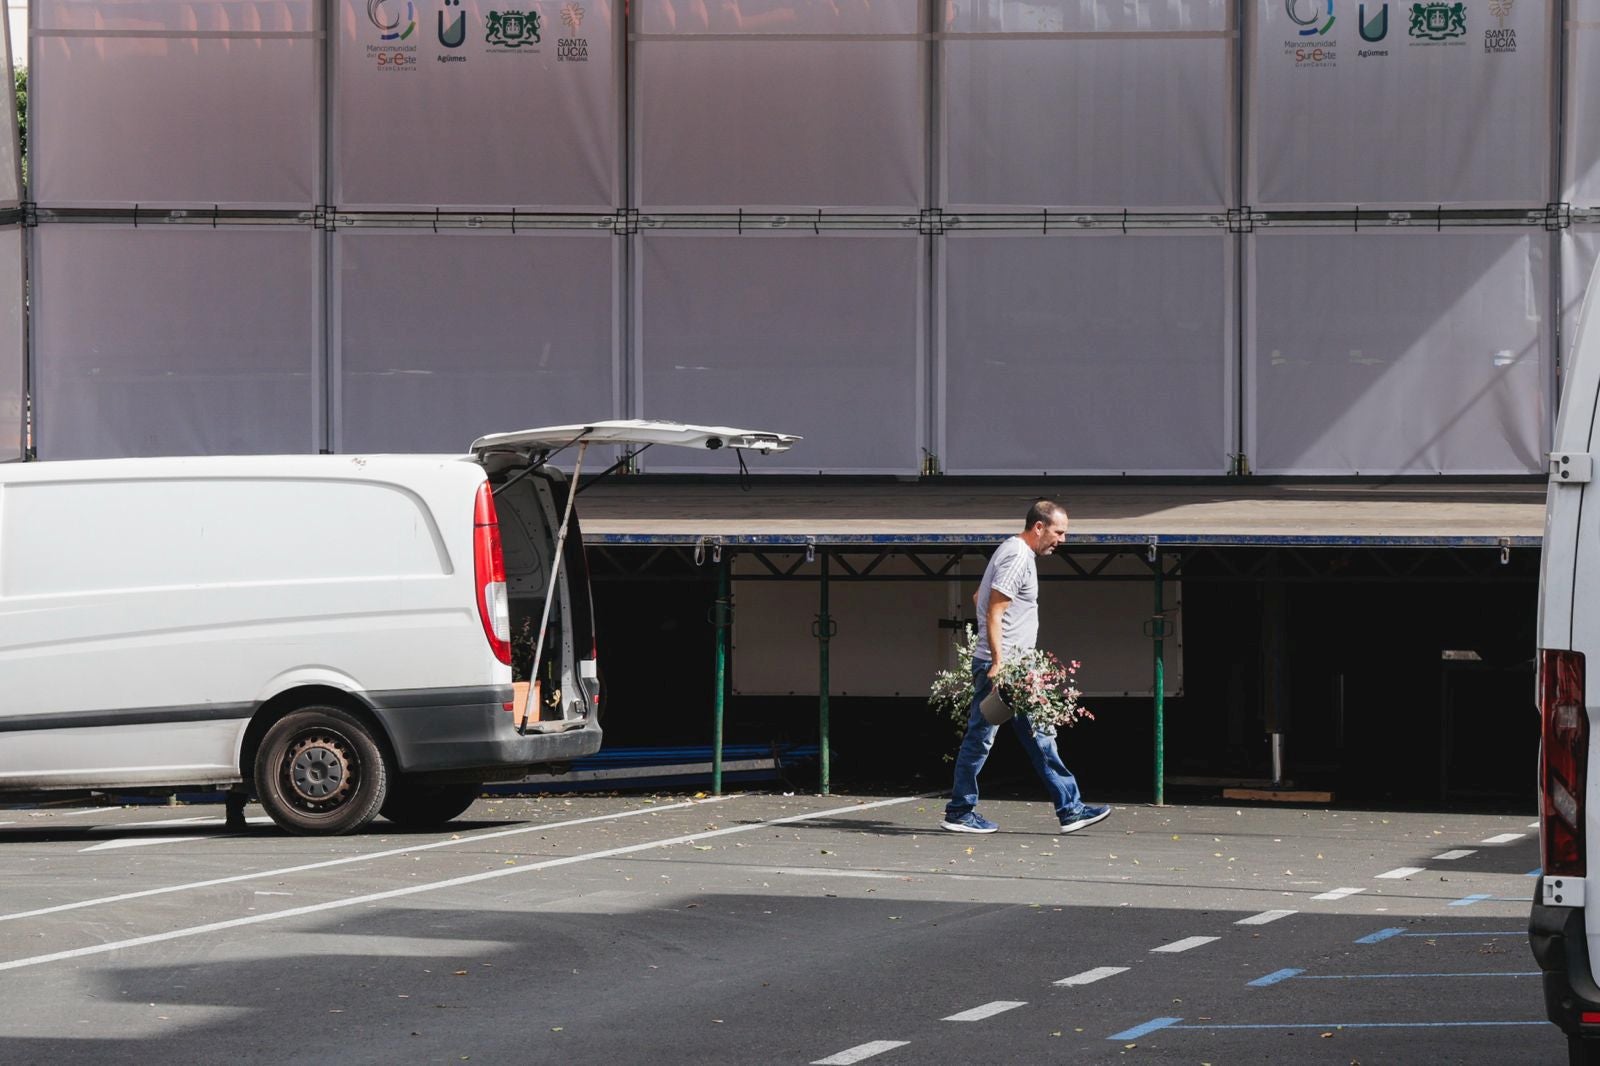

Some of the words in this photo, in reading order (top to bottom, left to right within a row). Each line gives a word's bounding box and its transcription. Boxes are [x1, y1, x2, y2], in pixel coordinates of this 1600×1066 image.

[1484, 29, 1517, 39] SANTA
[557, 38, 588, 47] SANTA
[1284, 40, 1337, 48] Mancomunidad
